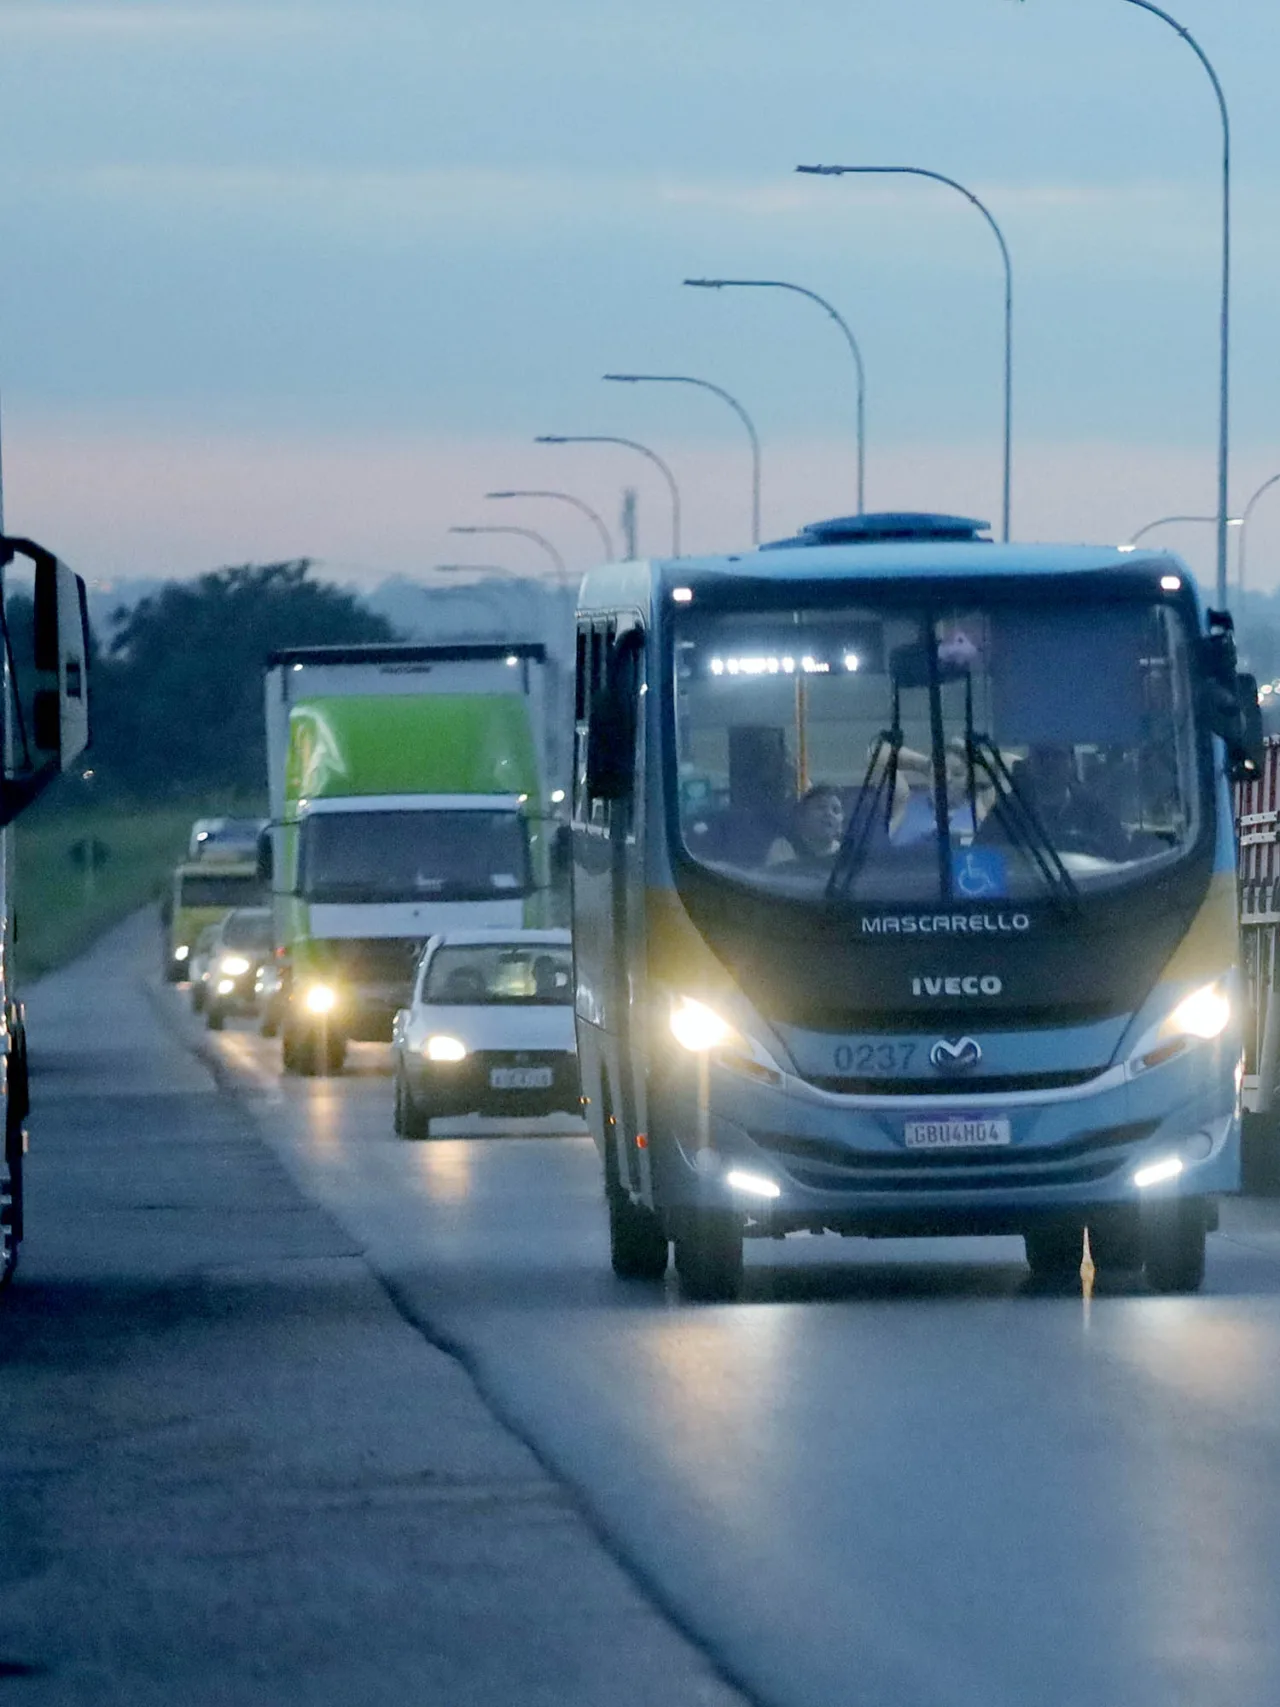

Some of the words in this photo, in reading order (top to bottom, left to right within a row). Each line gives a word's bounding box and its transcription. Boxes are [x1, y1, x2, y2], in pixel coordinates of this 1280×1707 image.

[861, 914, 1029, 933] MASCARELLO
[912, 975, 1002, 996] IVECO
[833, 1042, 916, 1071] 0237
